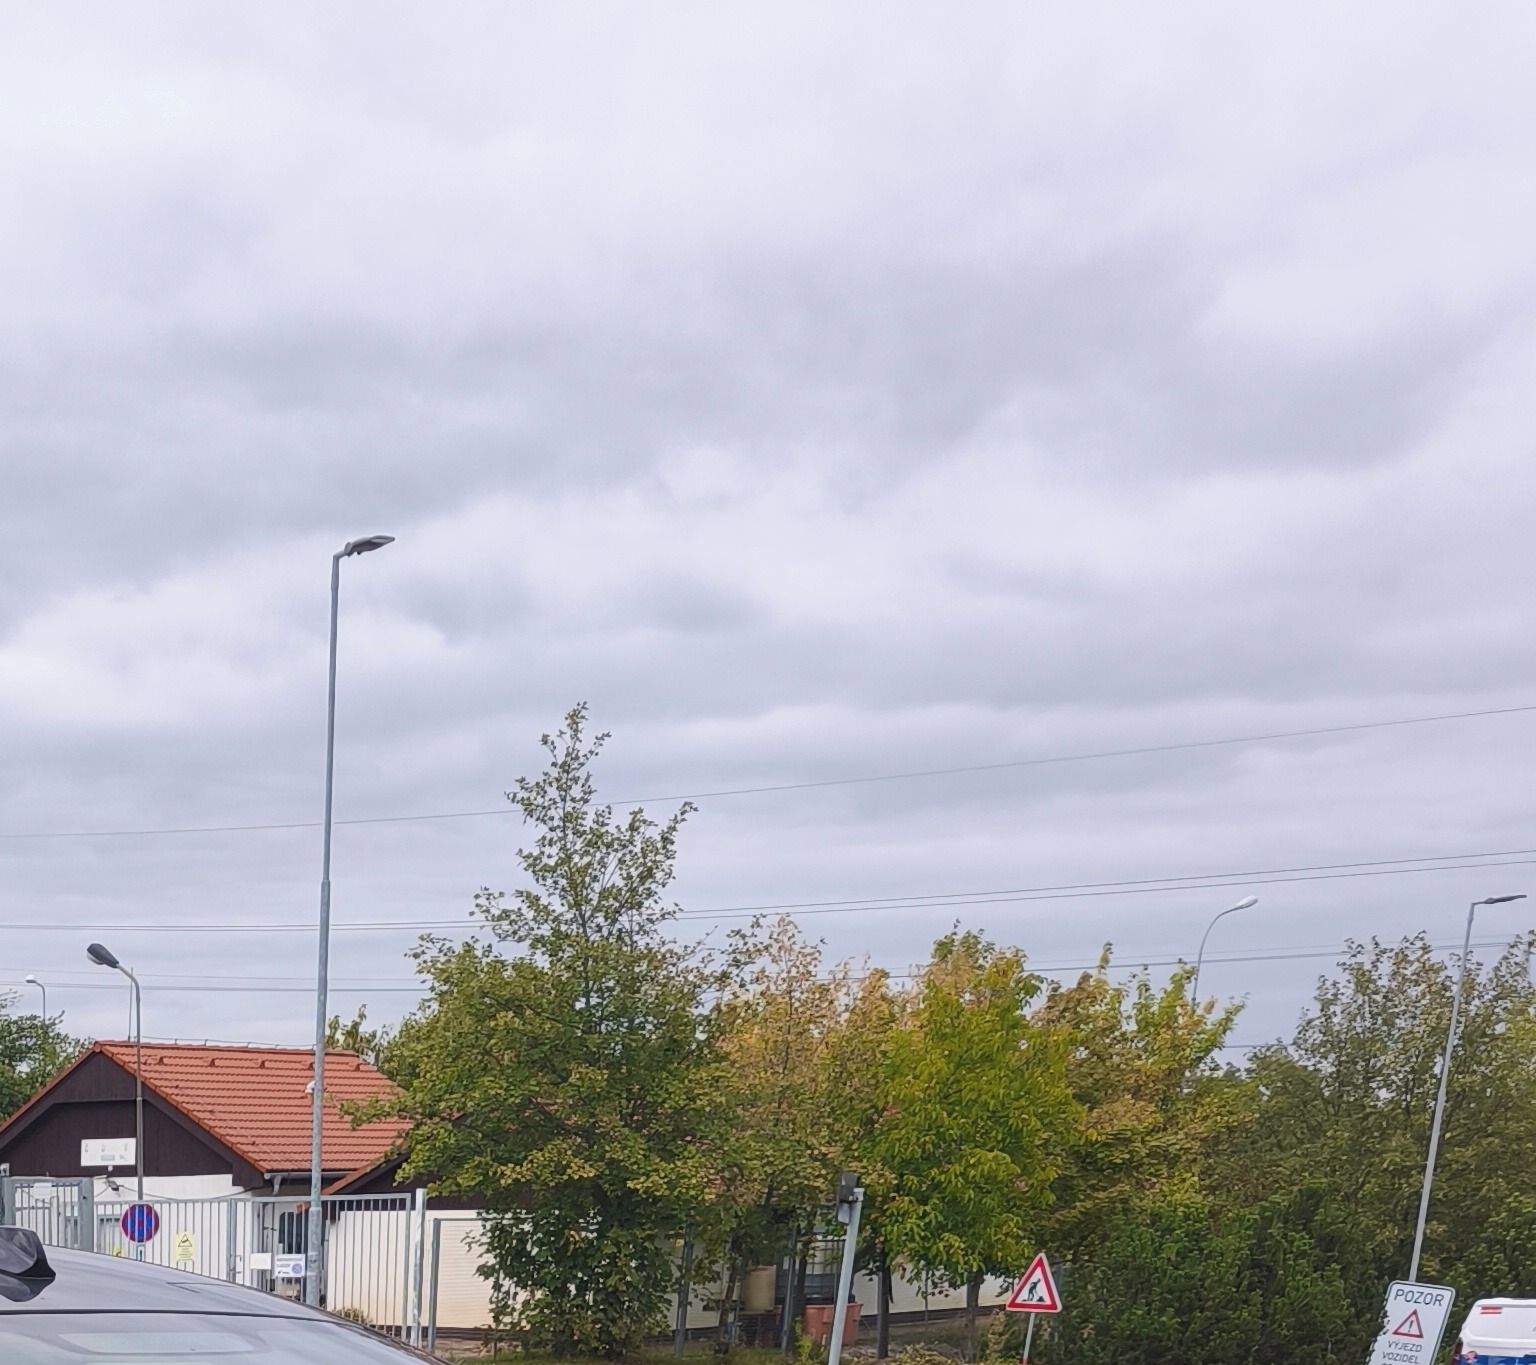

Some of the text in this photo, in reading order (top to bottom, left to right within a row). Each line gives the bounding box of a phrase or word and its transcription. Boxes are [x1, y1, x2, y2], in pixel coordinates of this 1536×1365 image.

[1394, 1289, 1444, 1307] POZOR
[1388, 1340, 1422, 1352] VÝJEZD
[1382, 1352, 1420, 1364] VOZIDEL
